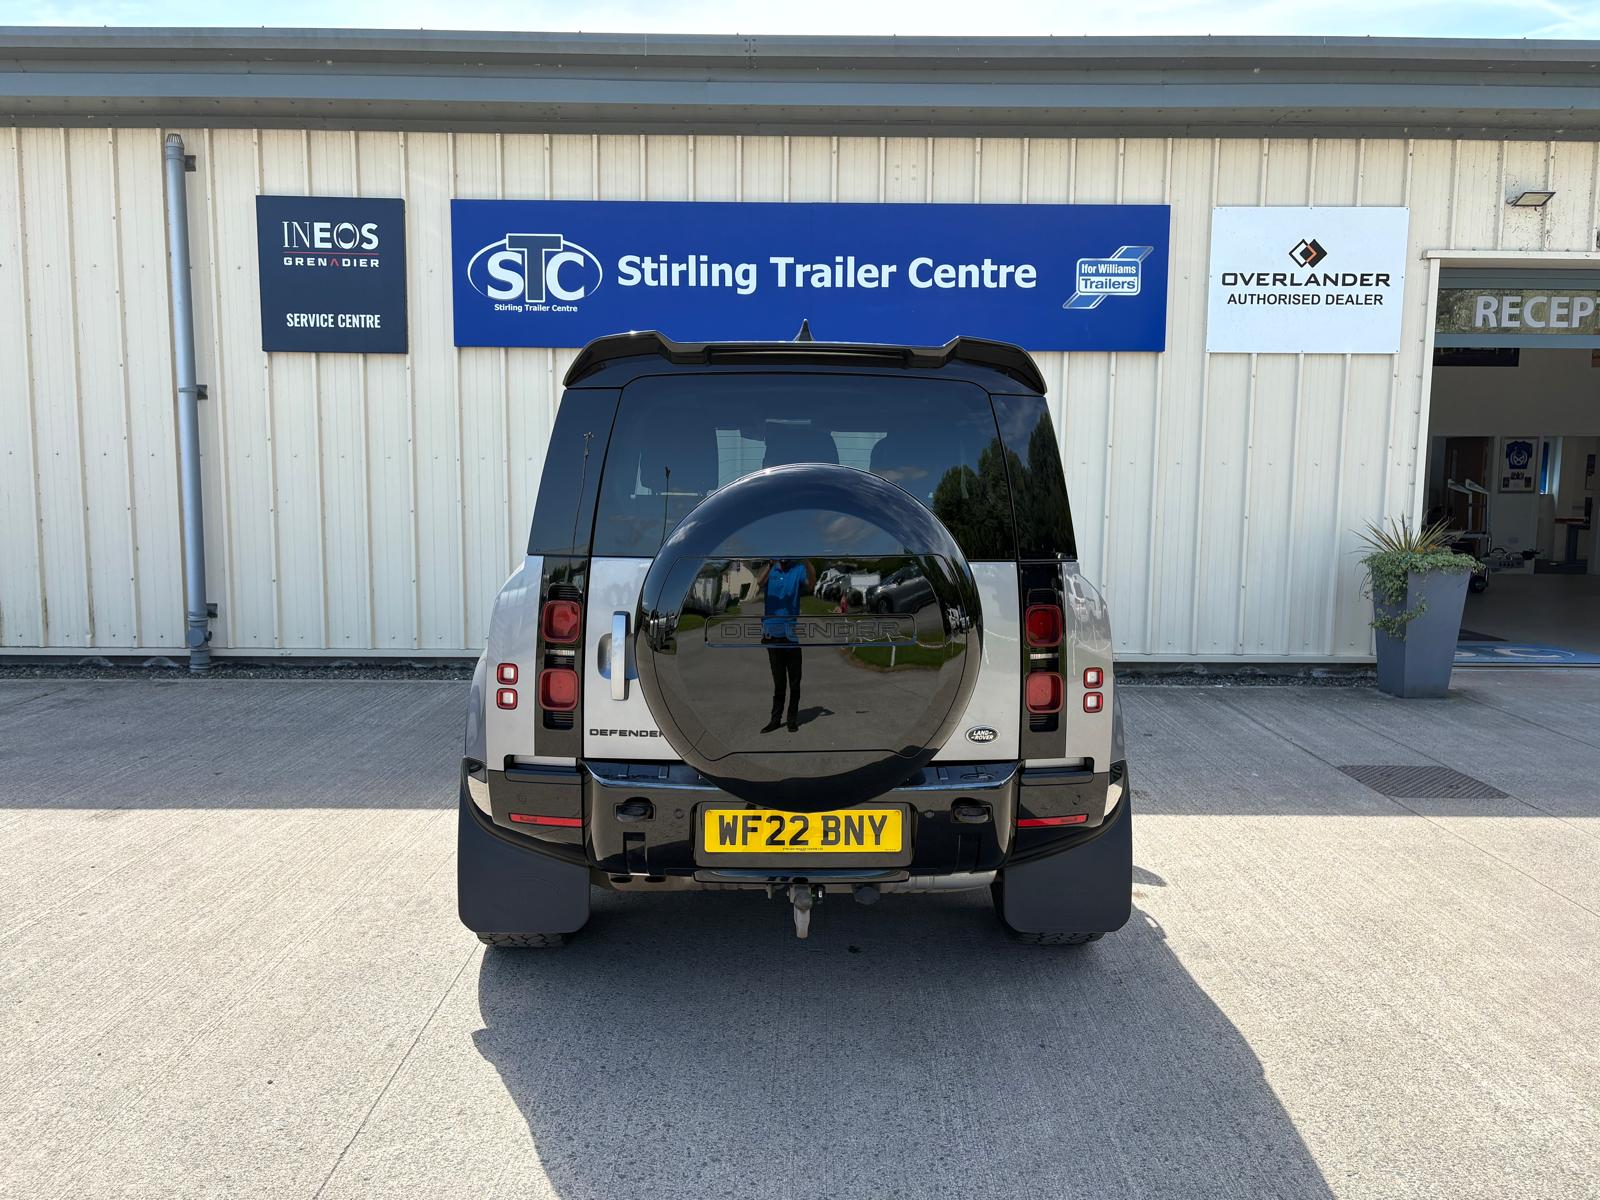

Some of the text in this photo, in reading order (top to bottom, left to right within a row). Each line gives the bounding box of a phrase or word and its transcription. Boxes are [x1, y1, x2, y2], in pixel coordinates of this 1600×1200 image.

[281, 221, 380, 250] INEOS
[283, 256, 380, 268] GRENADIER
[487, 233, 586, 303] STC
[1081, 263, 1137, 274] Ifor Williams
[617, 254, 1037, 295] Stirling Trailer Centre
[1221, 272, 1391, 287] OVERLANDER
[1081, 278, 1136, 290] Trailers
[1226, 293, 1384, 306] AUTHORISED DEALER
[494, 303, 578, 314] Stirling Trailer Centre
[1474, 296, 1600, 329] RECEP
[286, 312, 381, 329] SERVICE CENTRE
[718, 814, 888, 846] WF22 BNY
